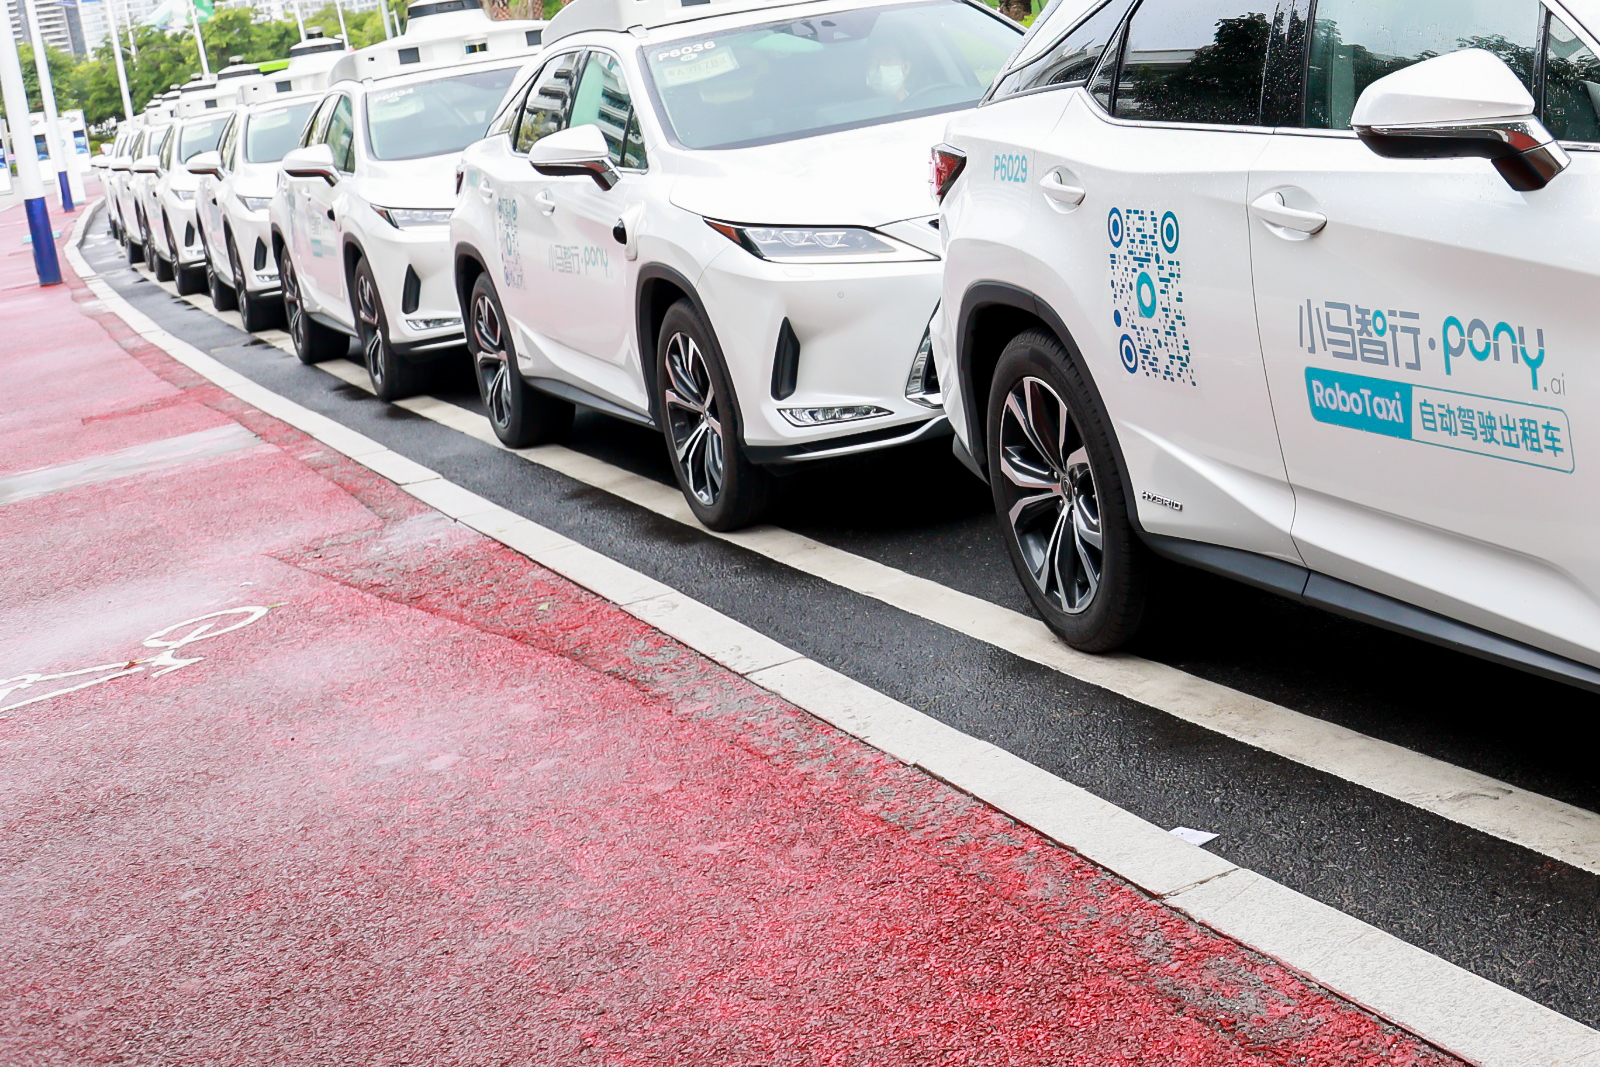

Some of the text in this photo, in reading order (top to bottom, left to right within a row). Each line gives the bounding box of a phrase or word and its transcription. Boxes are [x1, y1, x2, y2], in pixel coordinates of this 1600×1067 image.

[657, 40, 716, 62] P6036
[993, 153, 1027, 183] P6029
[548, 243, 580, 275] 小马智行
[1299, 298, 1421, 371] 小马智行
[1311, 379, 1404, 423] RoboTaxi
[1419, 398, 1565, 457] 自动驾驶出租车
[1141, 490, 1184, 512] HYBRID
